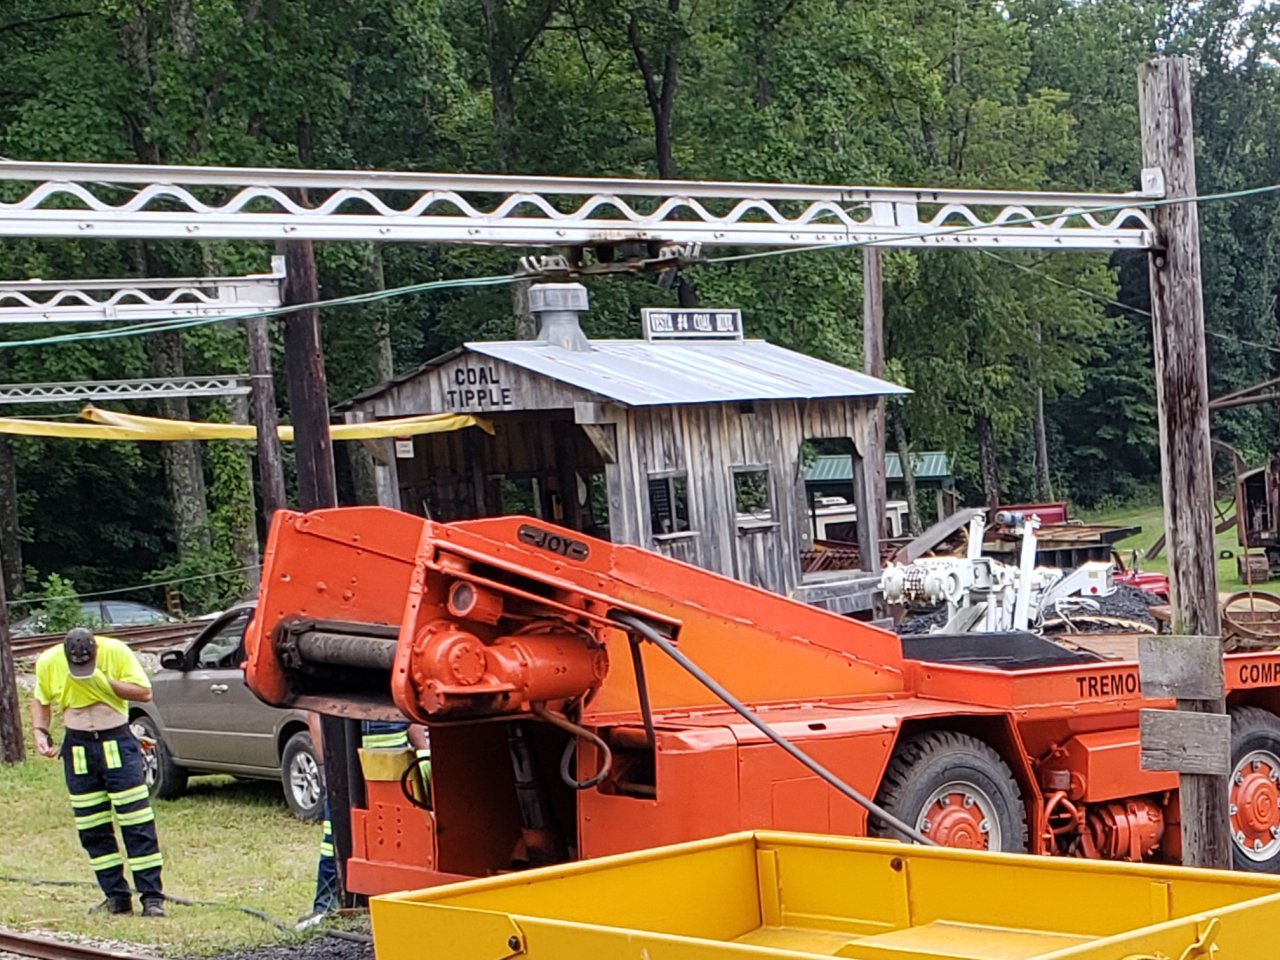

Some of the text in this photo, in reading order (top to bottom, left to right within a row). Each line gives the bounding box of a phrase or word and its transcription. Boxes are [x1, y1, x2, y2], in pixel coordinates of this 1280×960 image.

[455, 366, 500, 386] COAL
[447, 388, 513, 408] TIPPLE
[1076, 672, 1142, 698] TREMO
